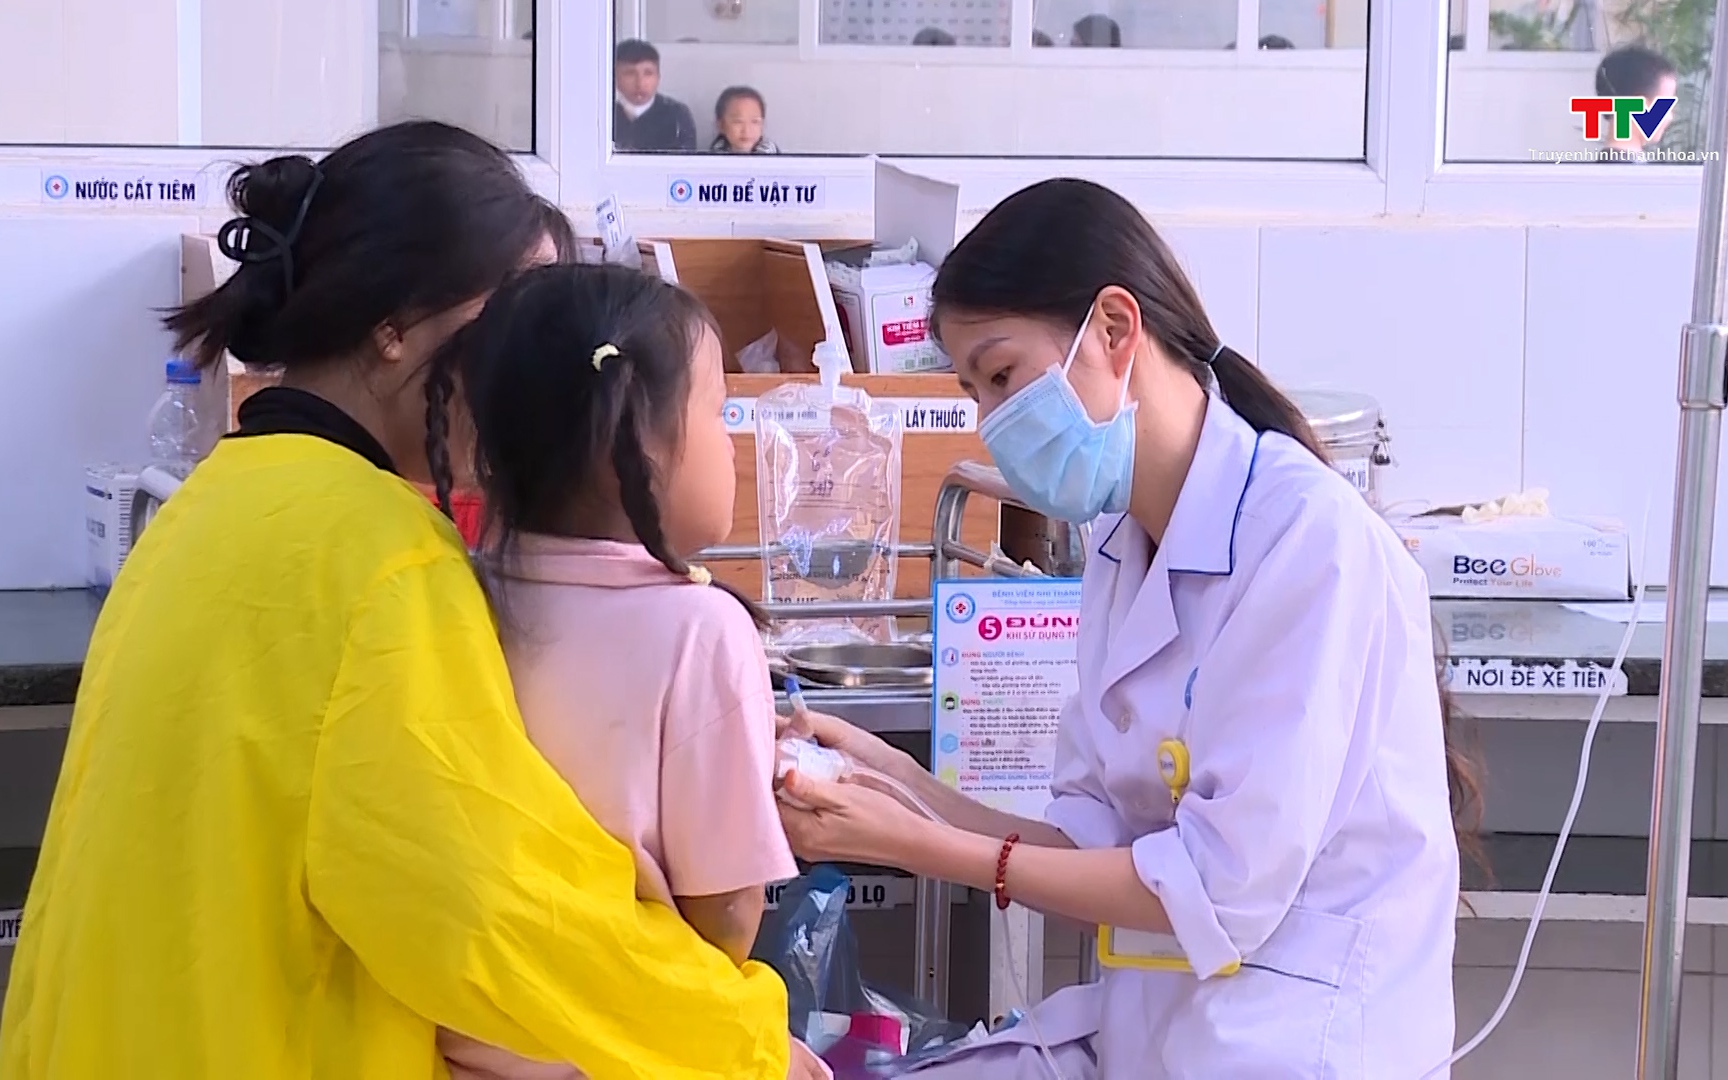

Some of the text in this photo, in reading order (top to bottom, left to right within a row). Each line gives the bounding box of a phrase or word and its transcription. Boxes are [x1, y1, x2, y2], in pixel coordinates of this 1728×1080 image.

[75, 176, 196, 201] NƯỚC CẤT TIÊM
[699, 177, 817, 207] NƠI ĐỂ VẬT TƯ
[905, 402, 966, 428] LẤY THUỐC
[1453, 554, 1562, 577] Bee Glove
[1452, 577, 1487, 586] Protect
[1467, 668, 1503, 686] NƠI
[1542, 671, 1566, 687] XE
[862, 884, 886, 908] LỌ
